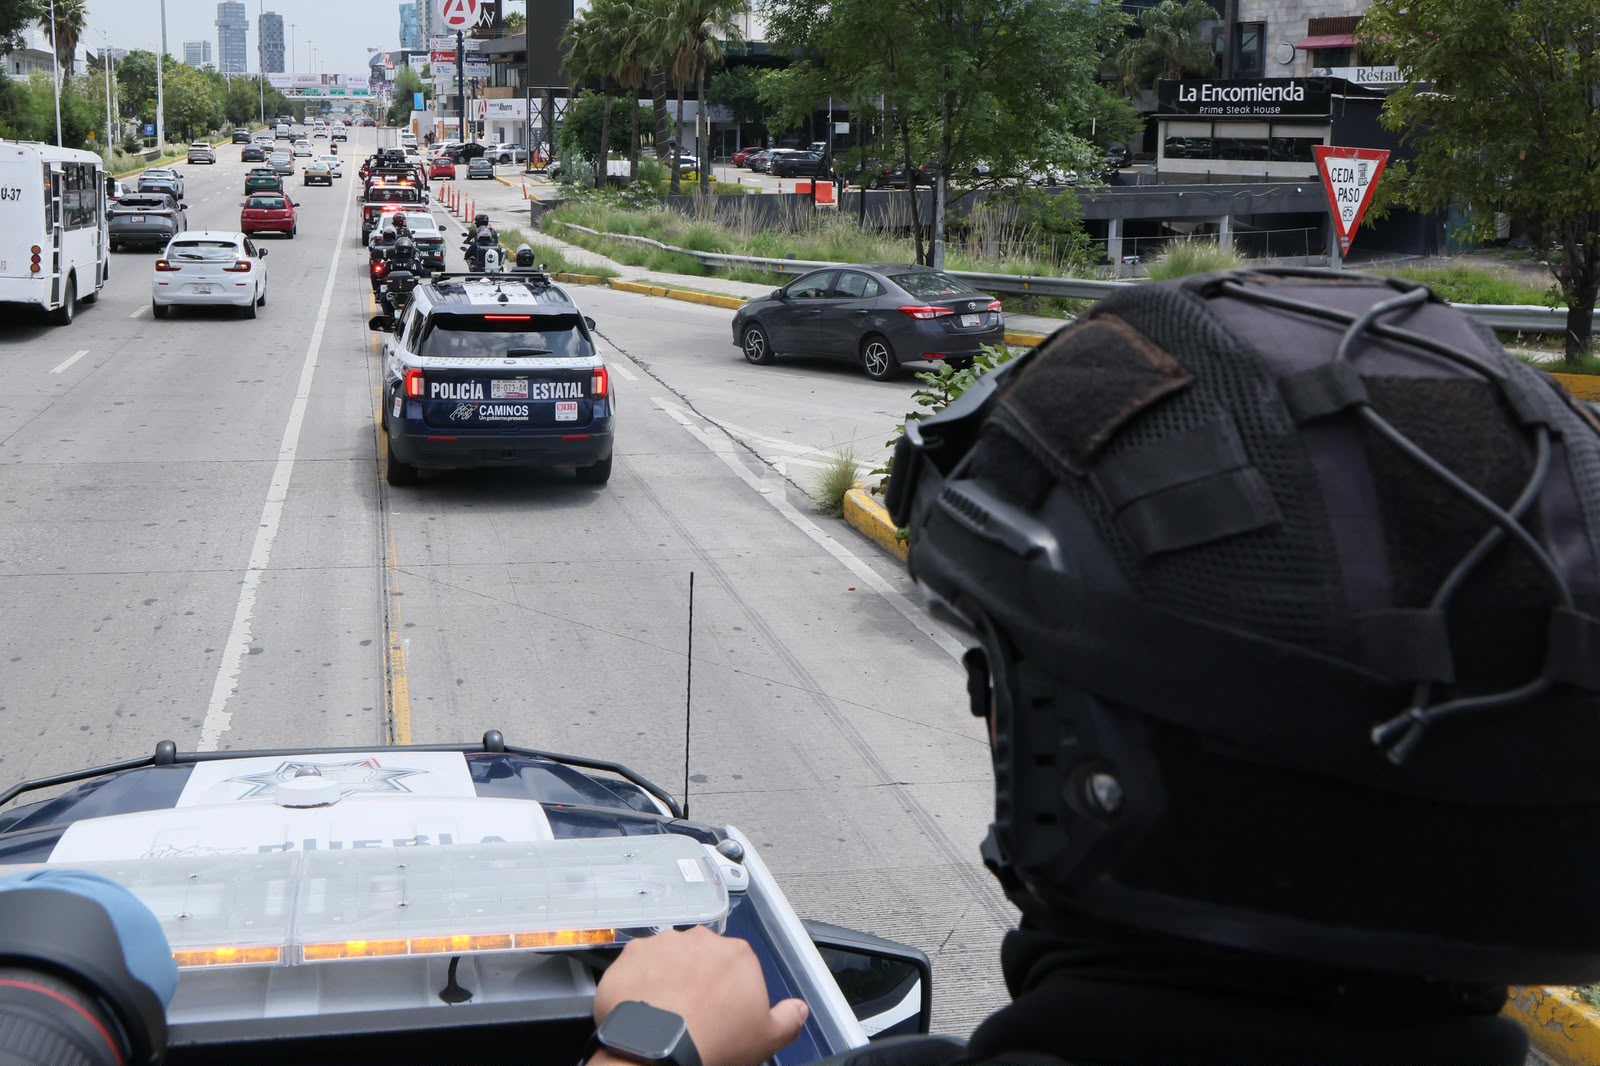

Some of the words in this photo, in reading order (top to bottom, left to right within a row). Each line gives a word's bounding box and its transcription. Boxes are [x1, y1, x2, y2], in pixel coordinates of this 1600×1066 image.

[1356, 68, 1405, 82] Restau
[1179, 84, 1197, 102] La
[1201, 81, 1304, 102] Encomienda
[1199, 106, 1223, 114] Prime
[1226, 106, 1250, 114] Steak
[1254, 106, 1281, 114] House
[1331, 167, 1355, 183] CEDA
[1337, 187, 1360, 203] PASO
[431, 380, 484, 400] POLICÍA
[533, 382, 584, 400] ESTATAL
[479, 405, 529, 416] CAMINOS
